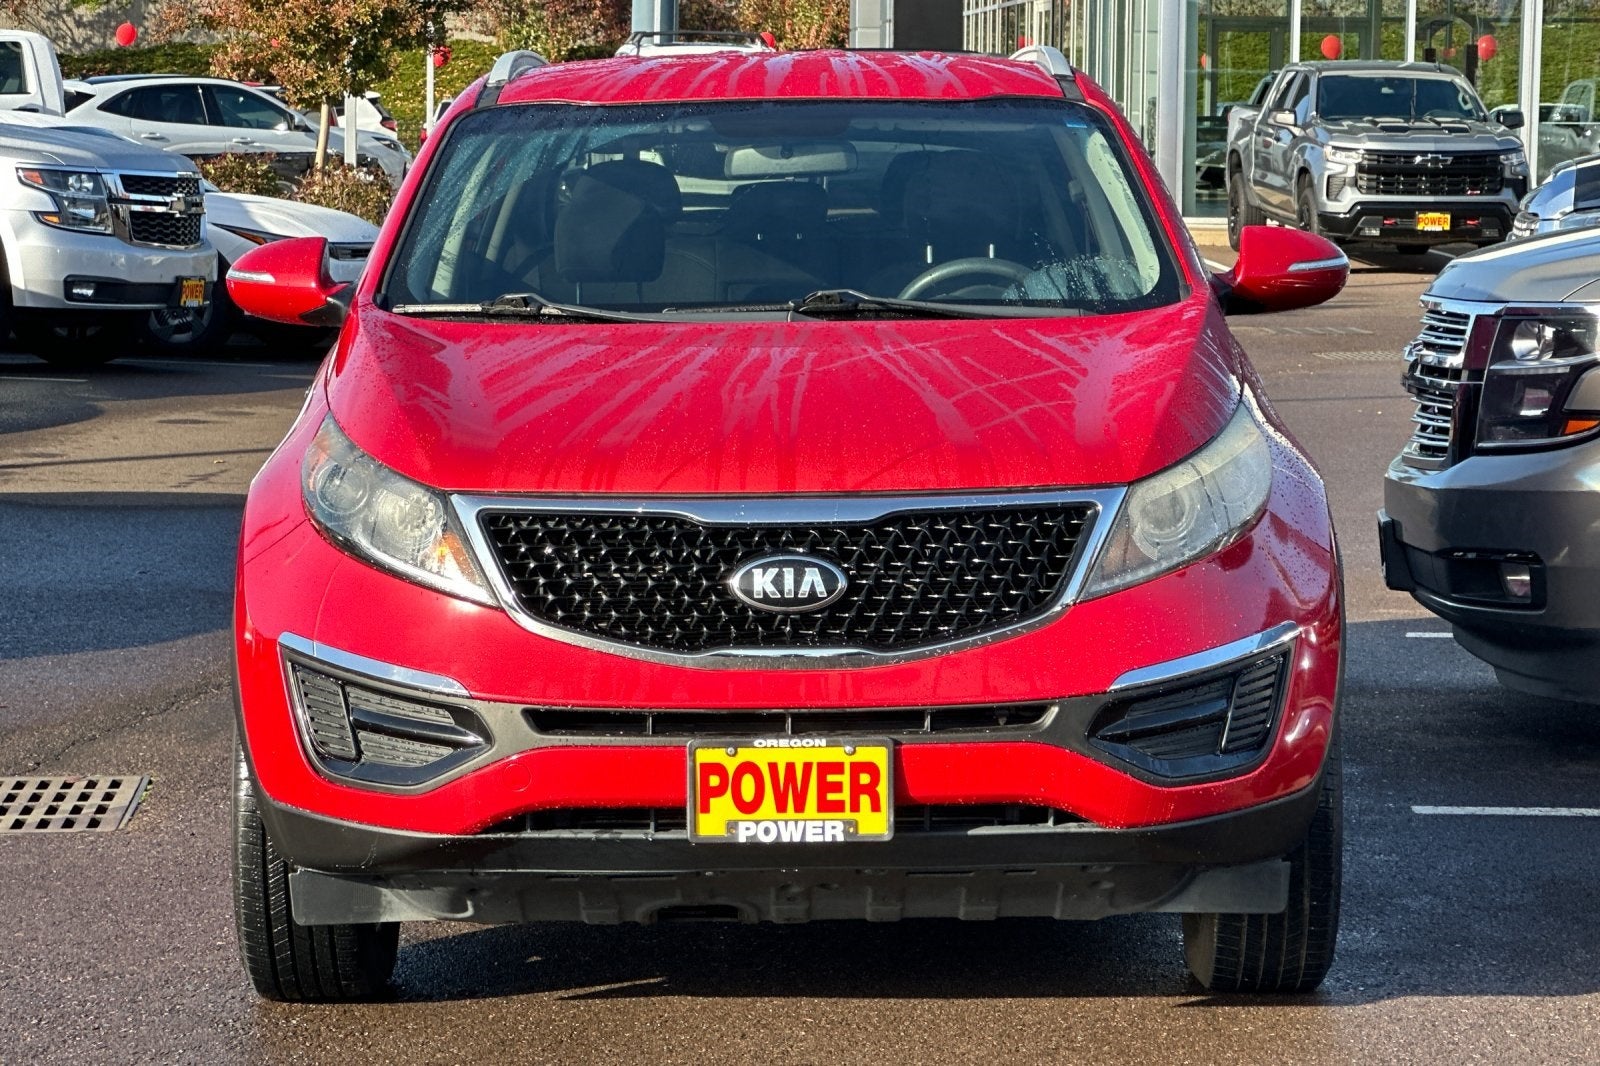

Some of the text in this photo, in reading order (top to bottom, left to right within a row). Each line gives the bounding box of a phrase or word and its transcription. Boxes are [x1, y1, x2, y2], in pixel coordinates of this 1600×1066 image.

[1417, 216, 1449, 226] POWER
[182, 283, 203, 299] POWER
[752, 568, 828, 598] KIA
[753, 738, 827, 748] OREGON
[699, 761, 882, 815] POWER
[738, 820, 845, 843] POWER
